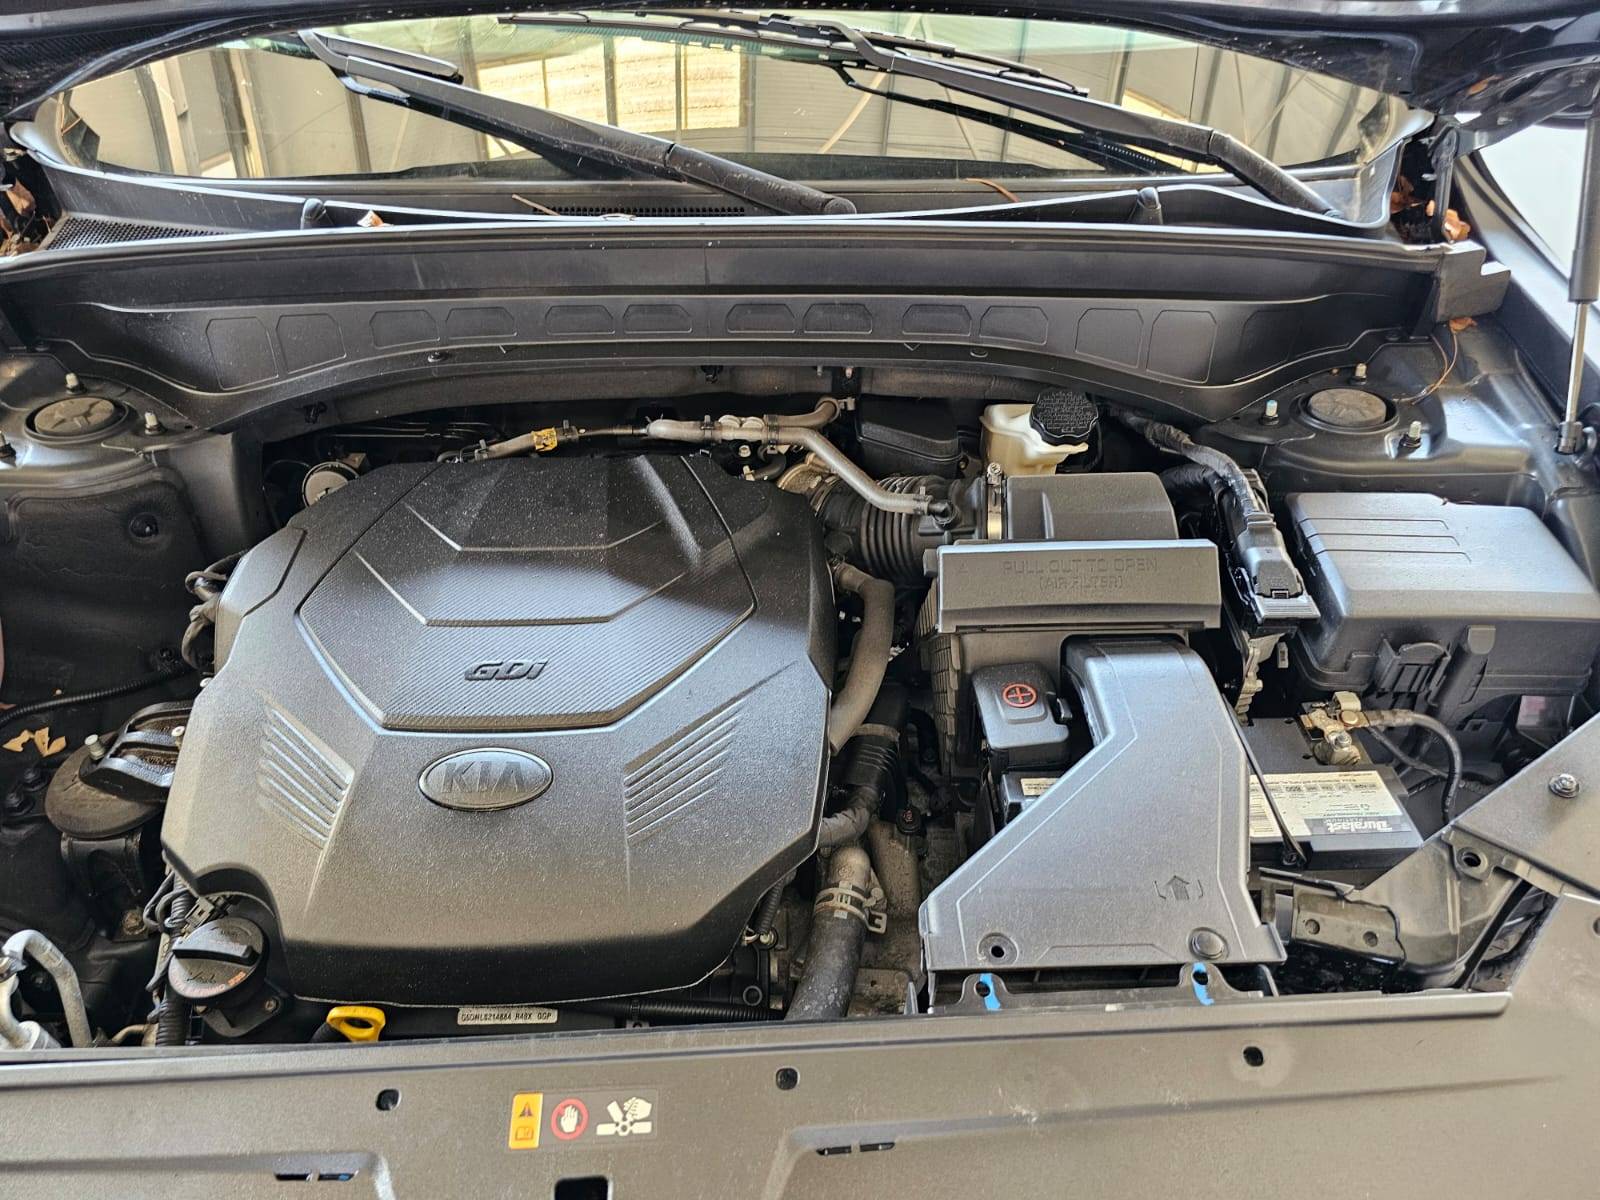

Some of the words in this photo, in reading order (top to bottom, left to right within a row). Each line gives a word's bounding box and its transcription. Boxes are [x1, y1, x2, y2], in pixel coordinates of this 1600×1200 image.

[1003, 560, 1043, 575] PULL
[1049, 559, 1082, 574] OUT
[1086, 558, 1109, 573] TO
[1114, 557, 1158, 572] OPEN
[441, 760, 528, 793] KIA
[1326, 820, 1393, 833] Duralast
